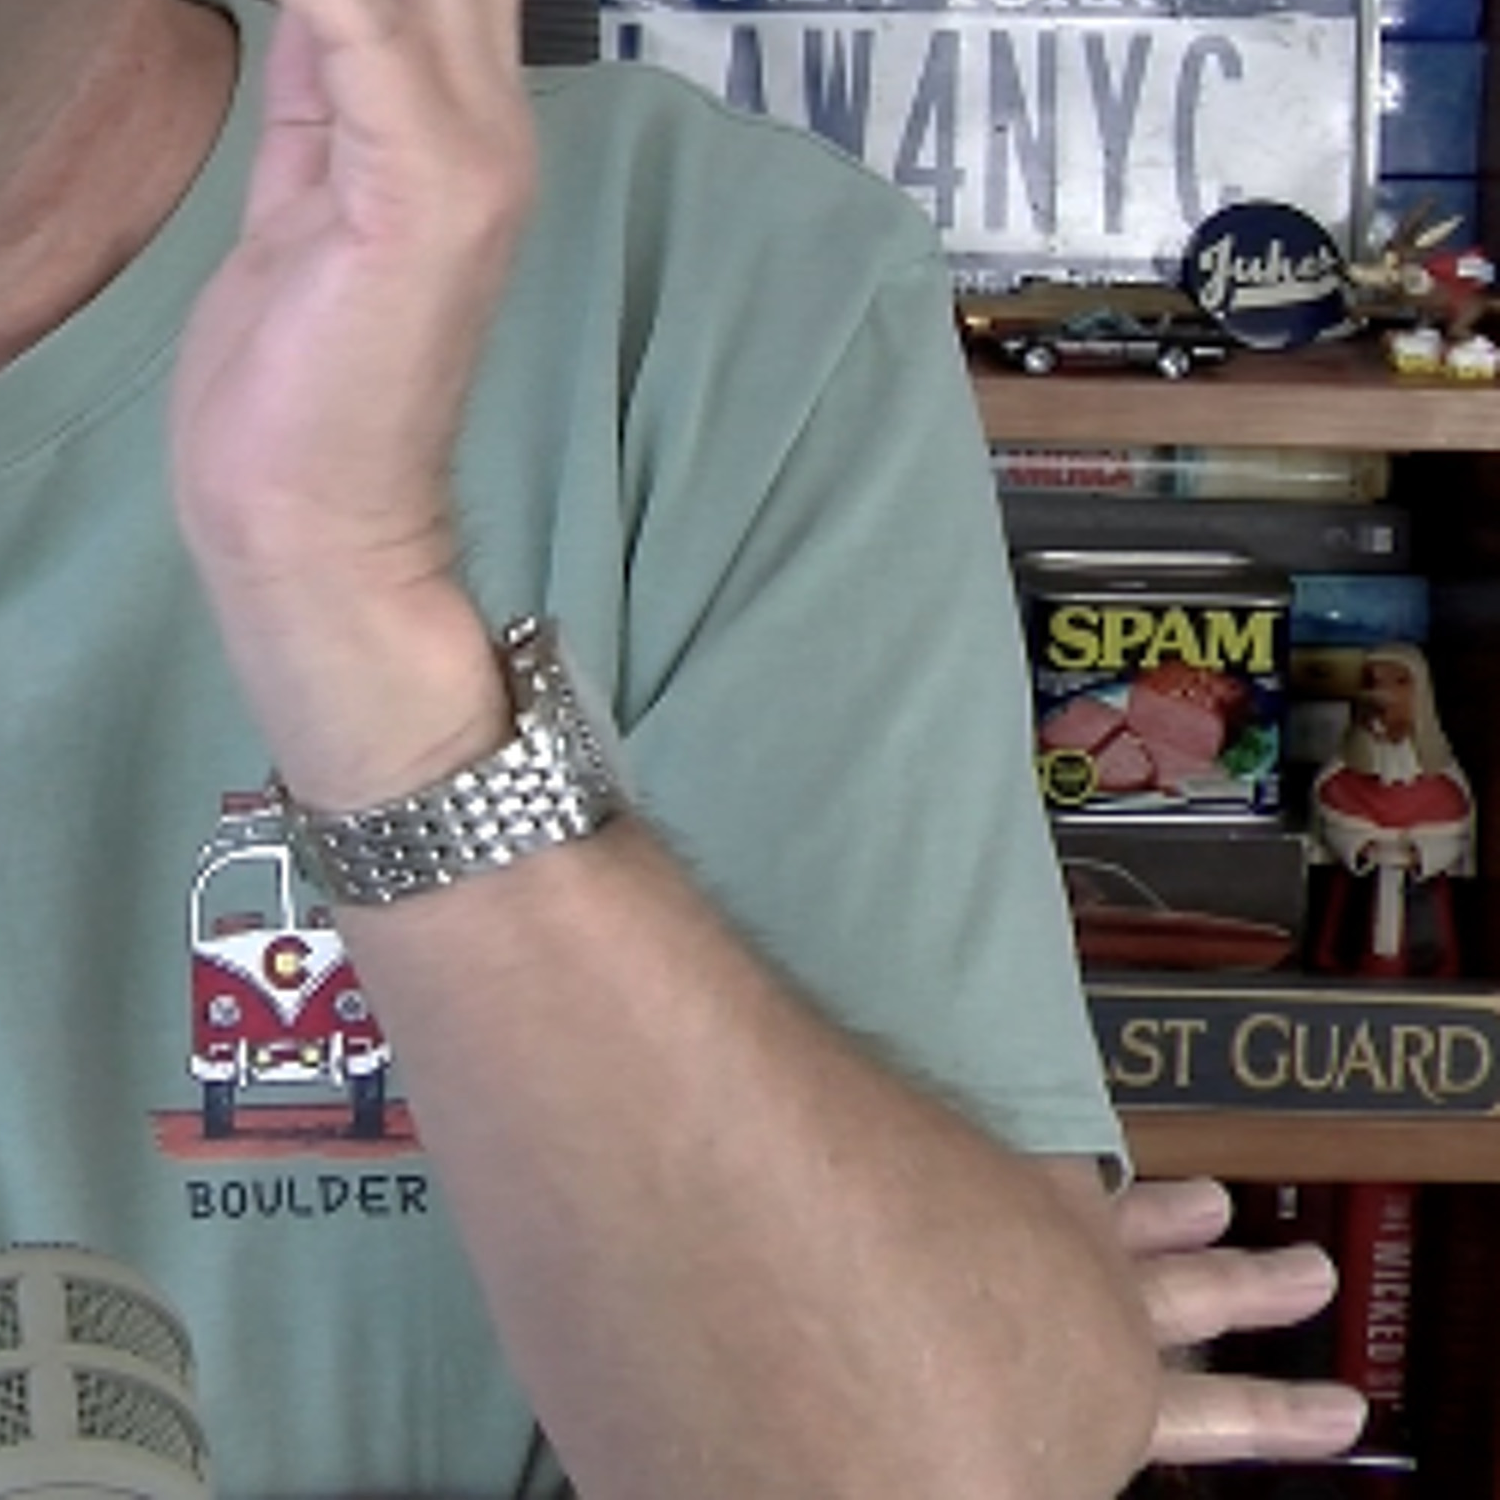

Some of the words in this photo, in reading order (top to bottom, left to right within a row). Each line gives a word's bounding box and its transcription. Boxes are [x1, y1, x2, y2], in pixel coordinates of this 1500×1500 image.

[1048, 604, 1283, 673] SPAM
[1232, 1013, 1492, 1102] GUARD
[186, 1174, 429, 1220] BOULDER
[1366, 1241, 1413, 1363] WICKED
